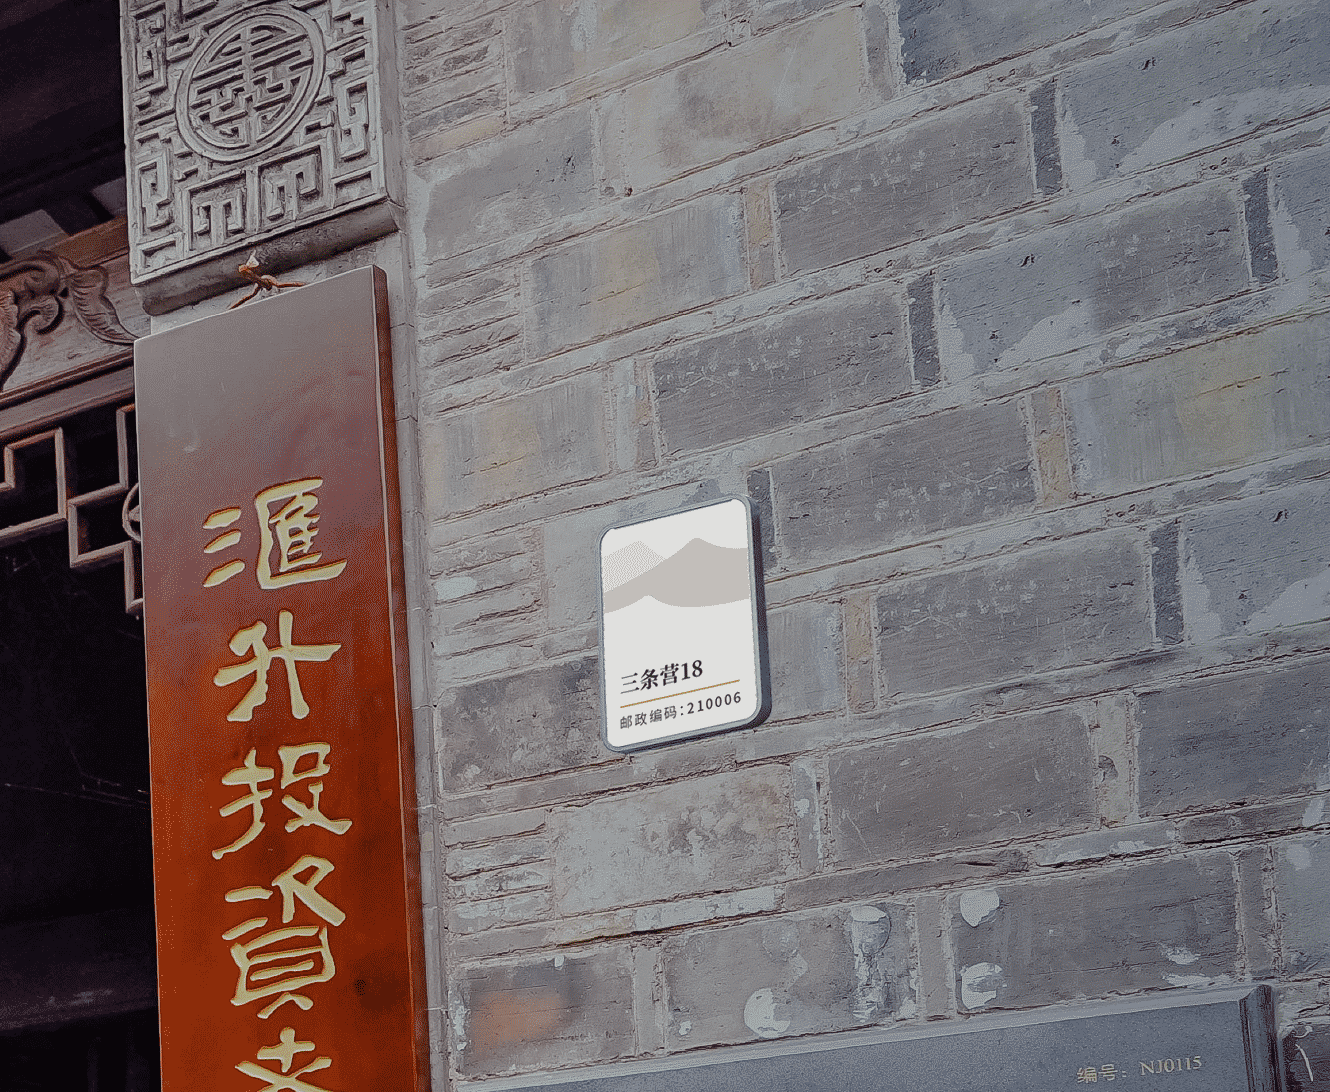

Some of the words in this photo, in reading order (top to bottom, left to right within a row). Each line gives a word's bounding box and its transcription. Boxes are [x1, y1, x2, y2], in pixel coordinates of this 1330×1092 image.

[620, 659, 703, 695] 三条营18
[619, 691, 742, 730] 邮政编码:210006
[1139, 1055, 1202, 1076] NJ0115
